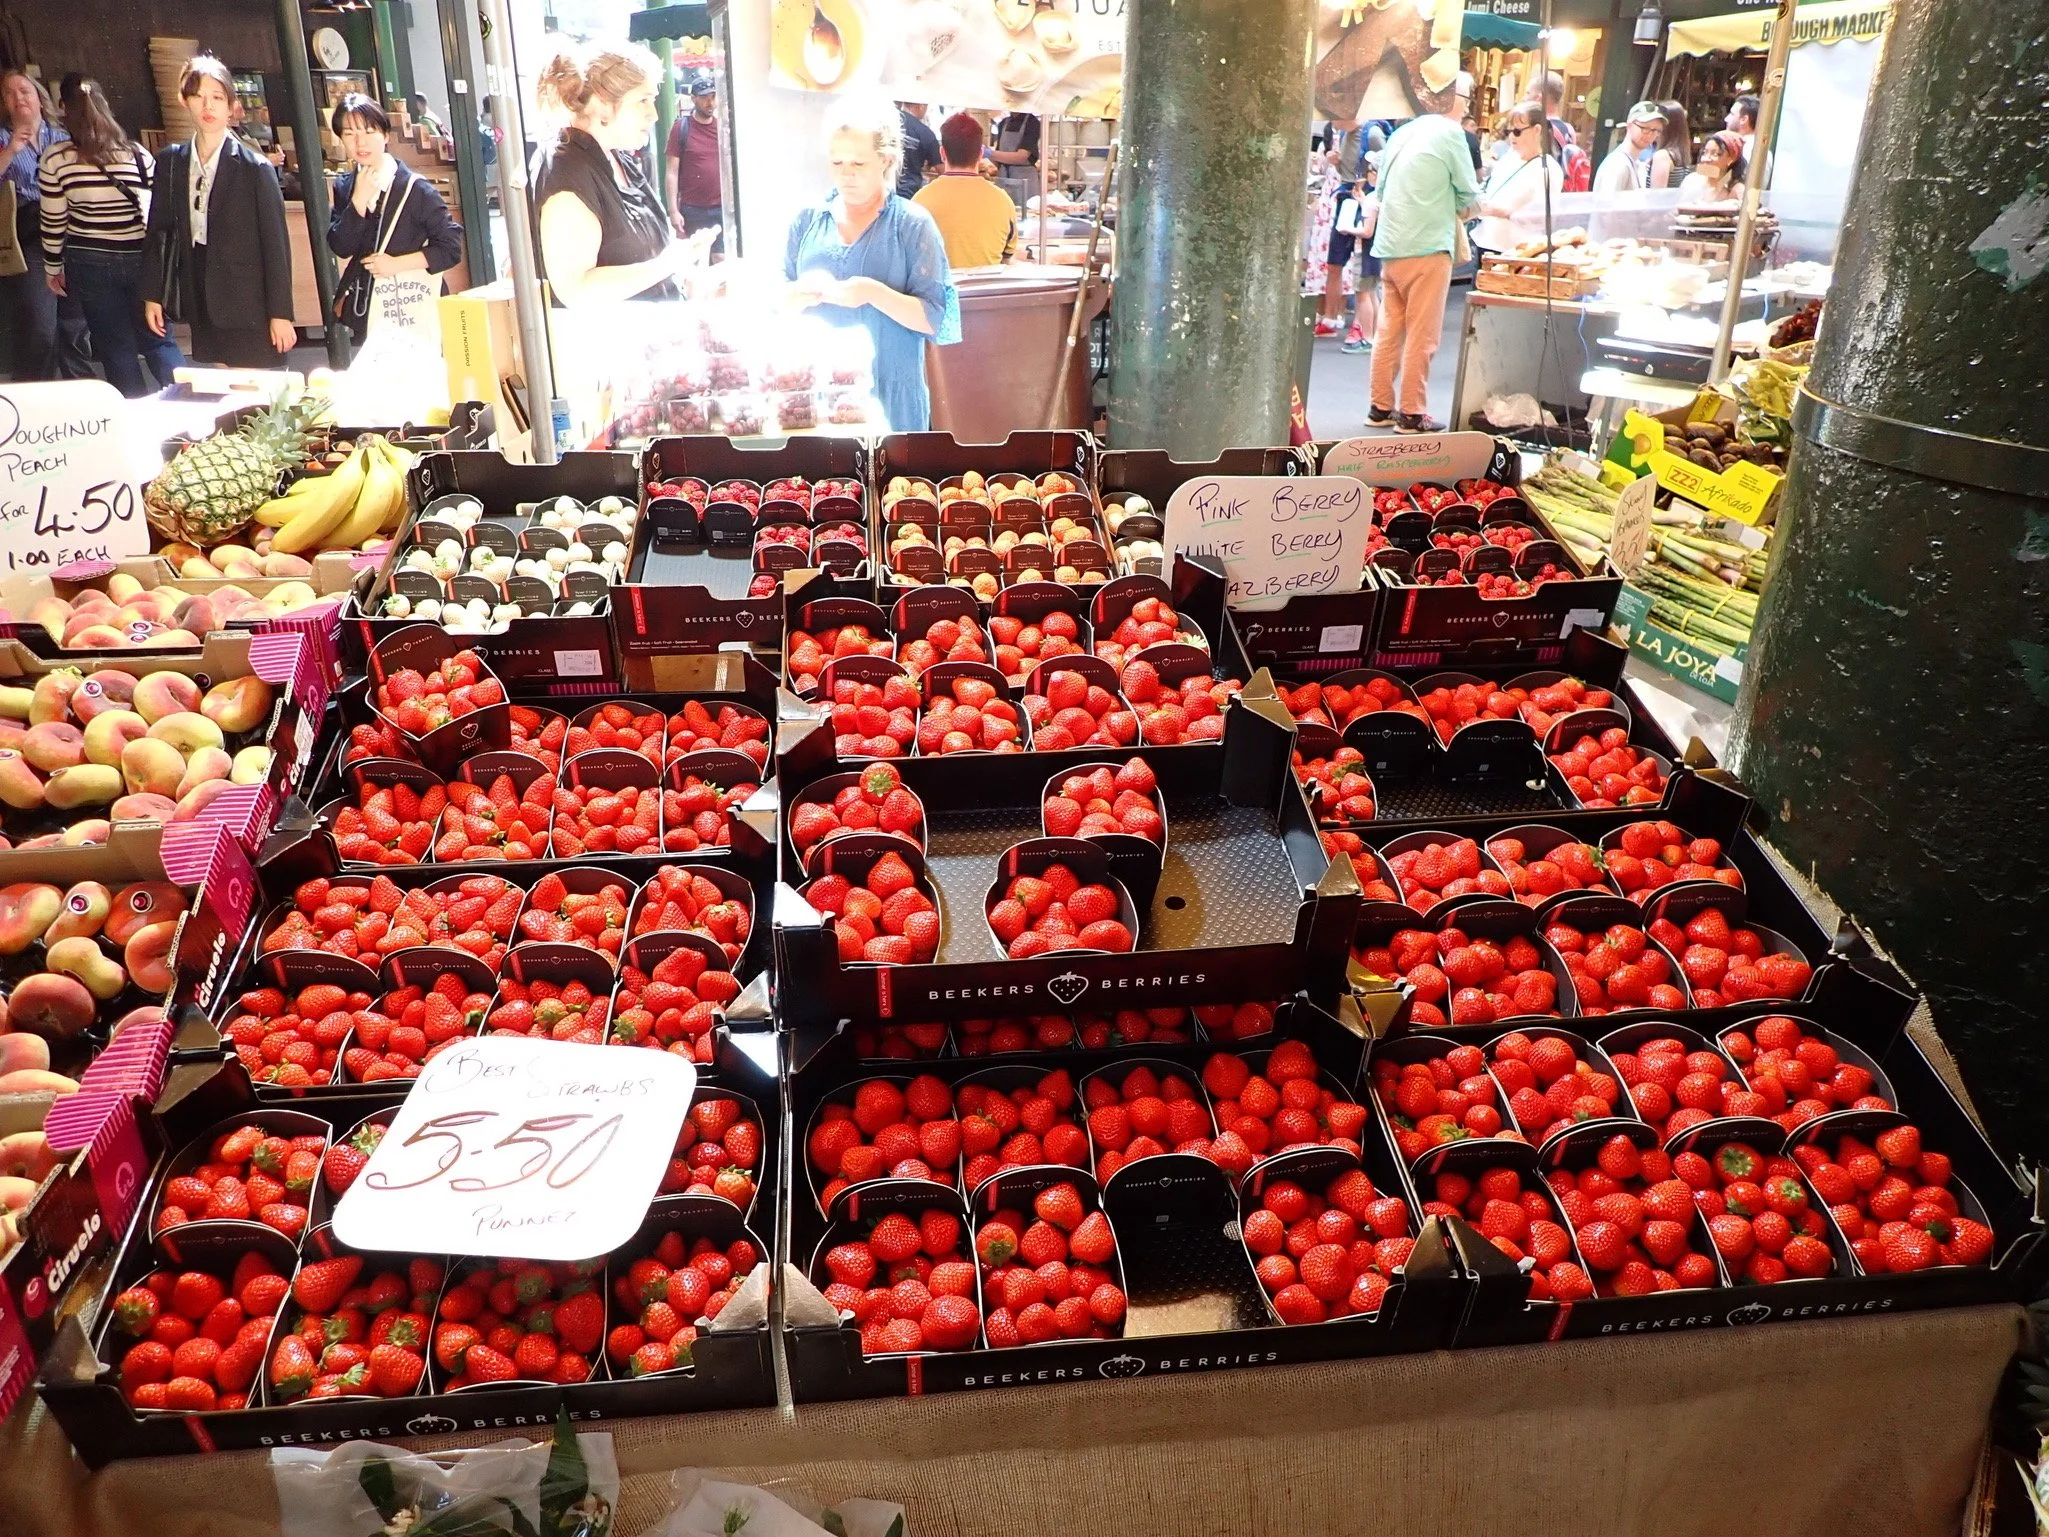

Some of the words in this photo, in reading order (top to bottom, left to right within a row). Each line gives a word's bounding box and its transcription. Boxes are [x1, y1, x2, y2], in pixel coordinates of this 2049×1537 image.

[1493, 0, 1530, 14] Cheese
[1761, 20, 1828, 42] BOUGH
[1832, 10, 1887, 37] MARKE
[374, 282, 432, 296] ROCHESTER
[383, 294, 423, 308] BORDER
[384, 309, 406, 318] RAL
[1349, 441, 1442, 458] STRAZBERRY
[0, 452, 68, 482] PEACH
[1271, 485, 1362, 522] BERRY
[1668, 469, 1699, 489] ZZ2
[1700, 484, 1753, 514] Afrikado
[34, 480, 134, 538] 4.50
[9, 549, 50, 571] 1.00
[58, 545, 112, 566] EACH
[1272, 529, 1342, 562] BERRY
[1227, 564, 1339, 596] AZBERRY
[685, 616, 731, 624] BEEKERS
[1635, 630, 1662, 656] LA
[1664, 646, 1717, 682] JOYA
[199, 932, 226, 1008] Ciruelo
[928, 984, 1034, 1000] BEEKERS
[1102, 974, 1206, 989] BERRIES
[424, 1049, 516, 1093] BEST
[47, 1213, 101, 1293] Ciruelo
[1601, 1315, 1713, 1333] BEEKERS
[1782, 1299, 1893, 1318] BERRIES
[964, 1367, 1084, 1386] BEEKERS
[1160, 1352, 1278, 1370] BERRIES
[260, 1426, 391, 1446] BEEKERS
